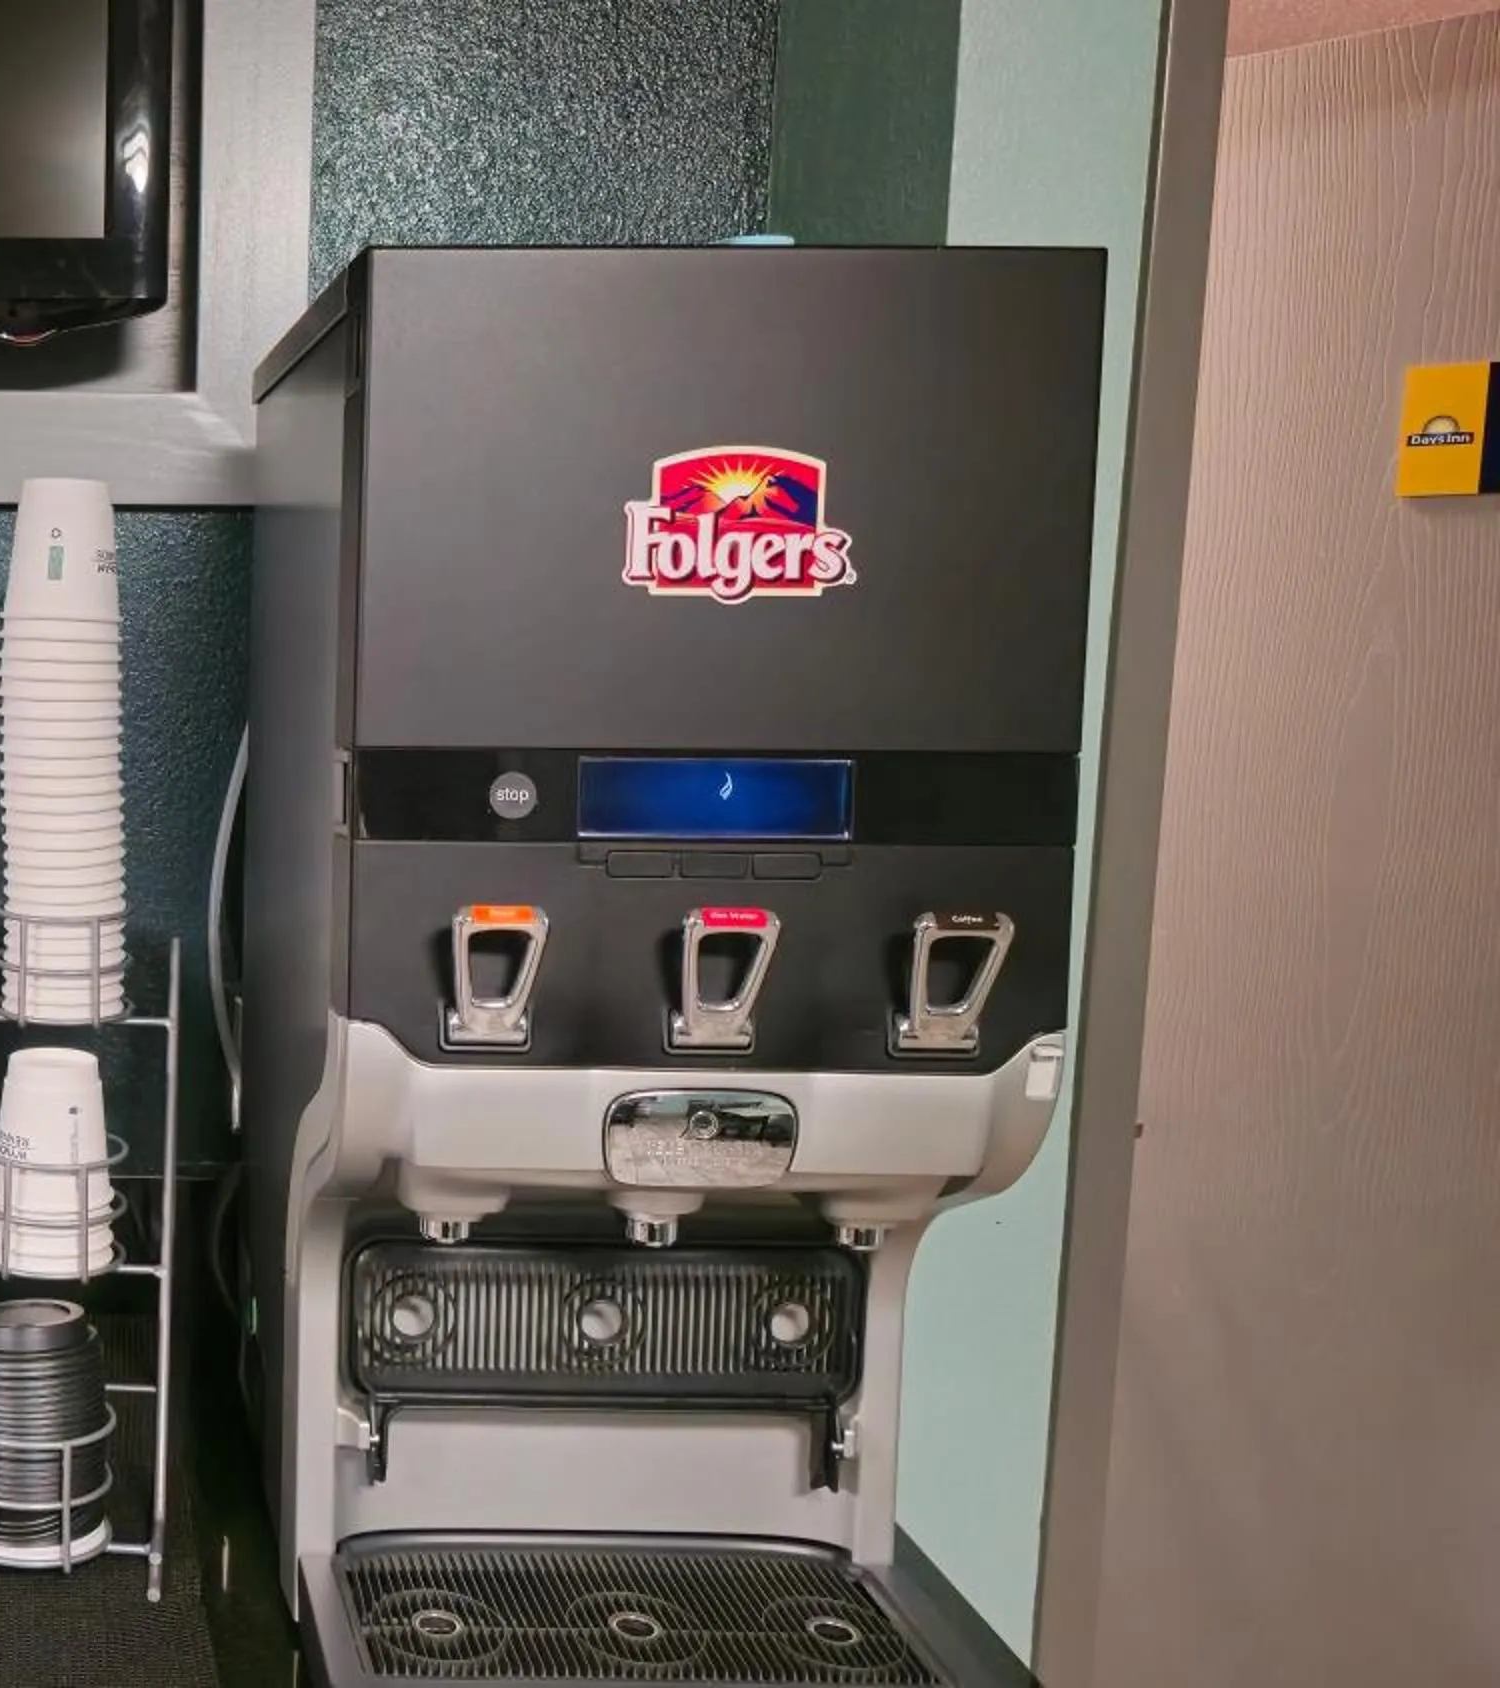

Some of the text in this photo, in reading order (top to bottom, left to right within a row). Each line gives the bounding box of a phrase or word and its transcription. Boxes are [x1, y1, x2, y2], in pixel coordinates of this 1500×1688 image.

[1411, 433, 1470, 445] Days Inn
[626, 502, 850, 602] Folgers
[496, 788, 529, 804] stop
[951, 914, 983, 924] Coffee
